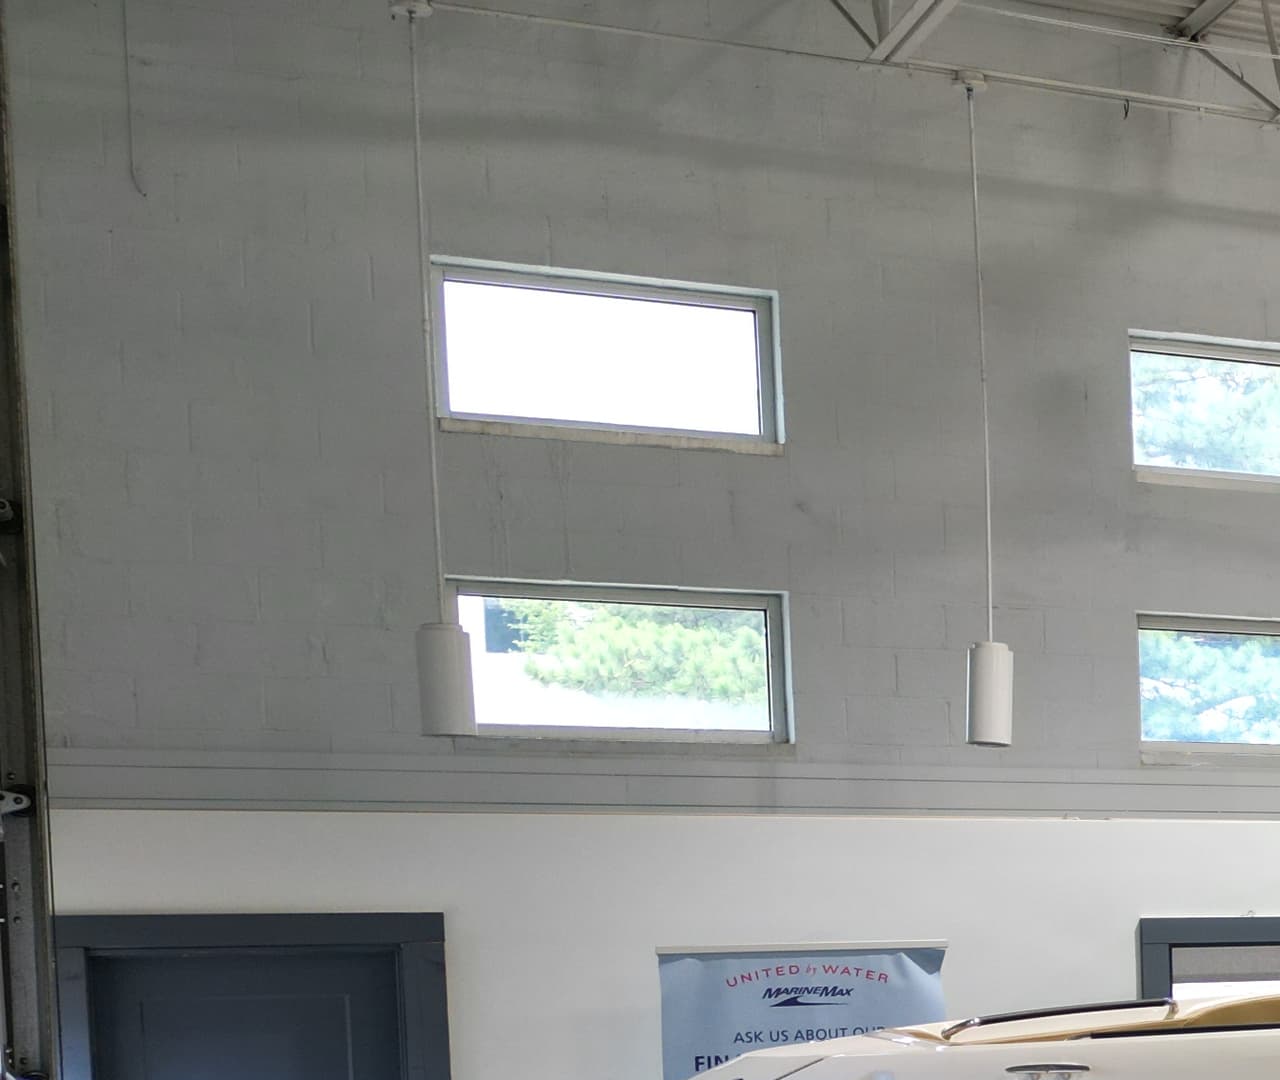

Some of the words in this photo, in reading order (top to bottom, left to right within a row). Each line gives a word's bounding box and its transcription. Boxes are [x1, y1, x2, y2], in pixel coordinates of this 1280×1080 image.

[726, 964, 801, 988] UNITED
[806, 963, 817, 976] by
[822, 964, 889, 985] WATER
[733, 1031, 764, 1044] ASK
[769, 1029, 789, 1043] US
[794, 1027, 849, 1042] ABOUT
[694, 1054, 740, 1072] FIN
